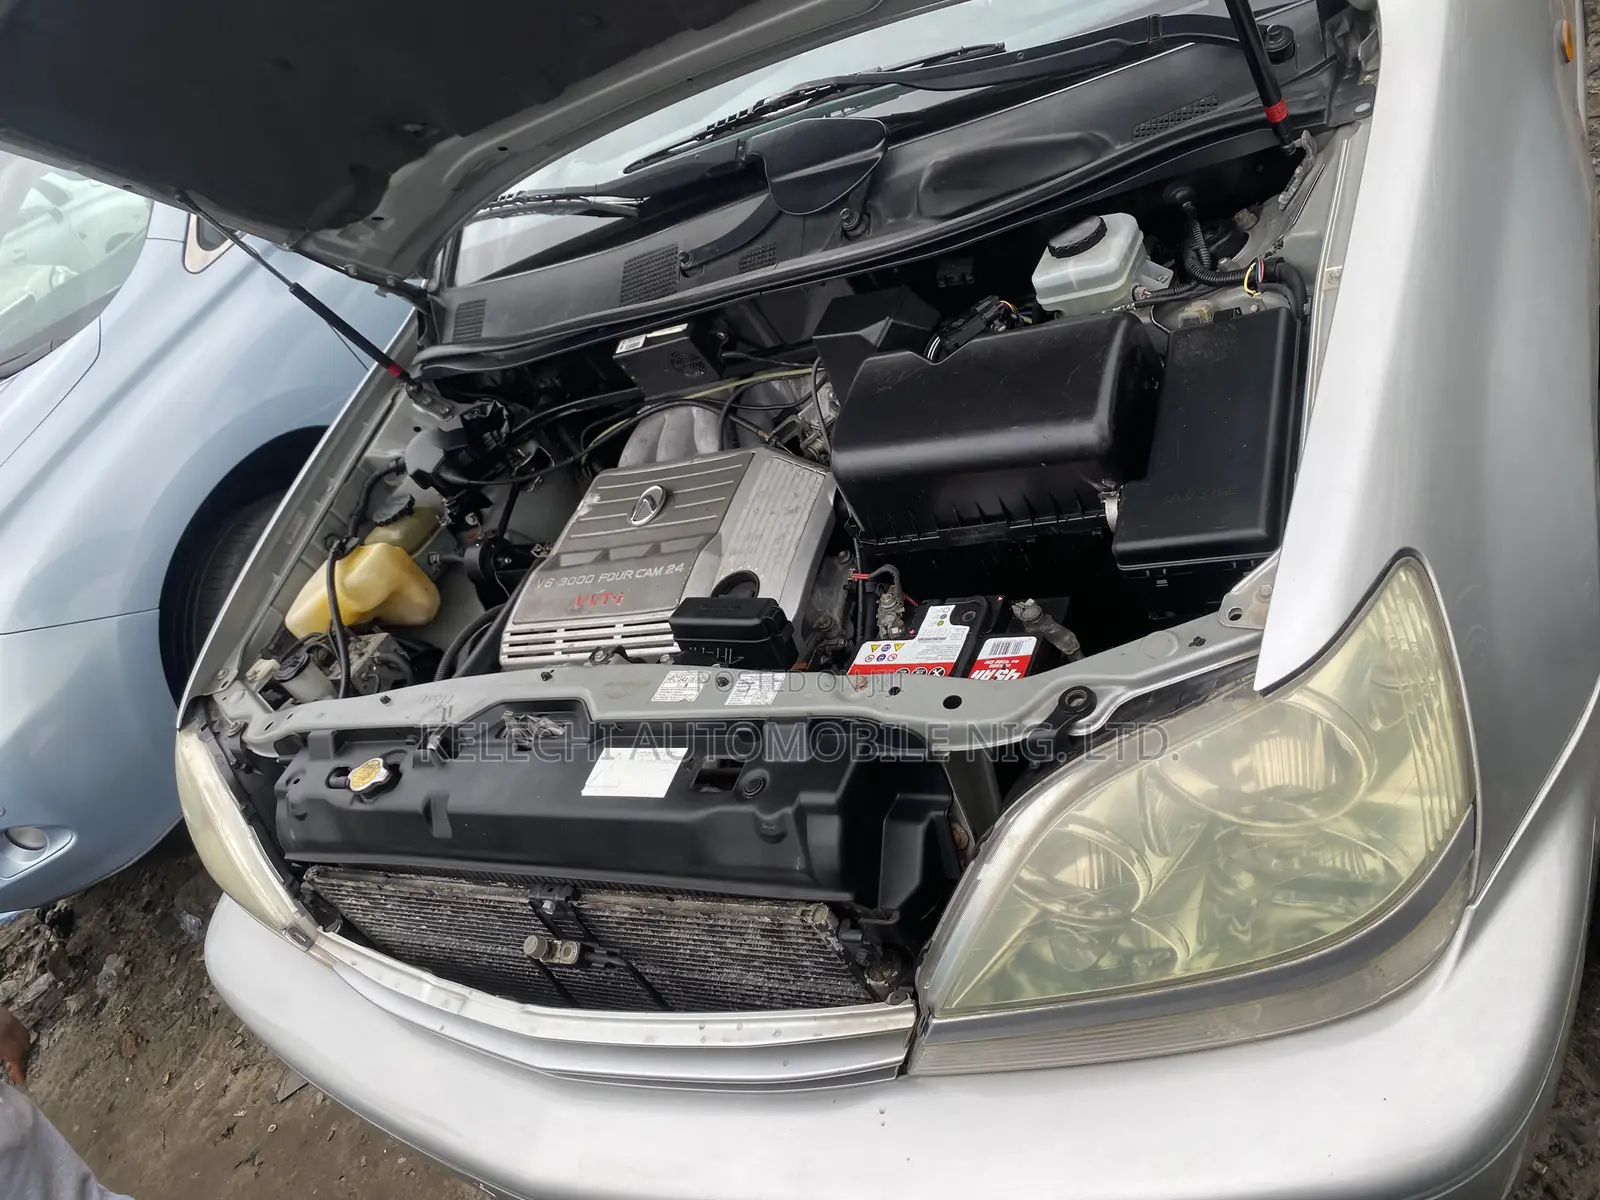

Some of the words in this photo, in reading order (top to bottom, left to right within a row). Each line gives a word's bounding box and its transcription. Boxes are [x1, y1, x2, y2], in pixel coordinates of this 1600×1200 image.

[537, 577, 555, 589] V6
[558, 574, 595, 586] 3000
[598, 569, 634, 582] FOUR
[635, 566, 664, 578] CAM
[665, 562, 684, 575] 24
